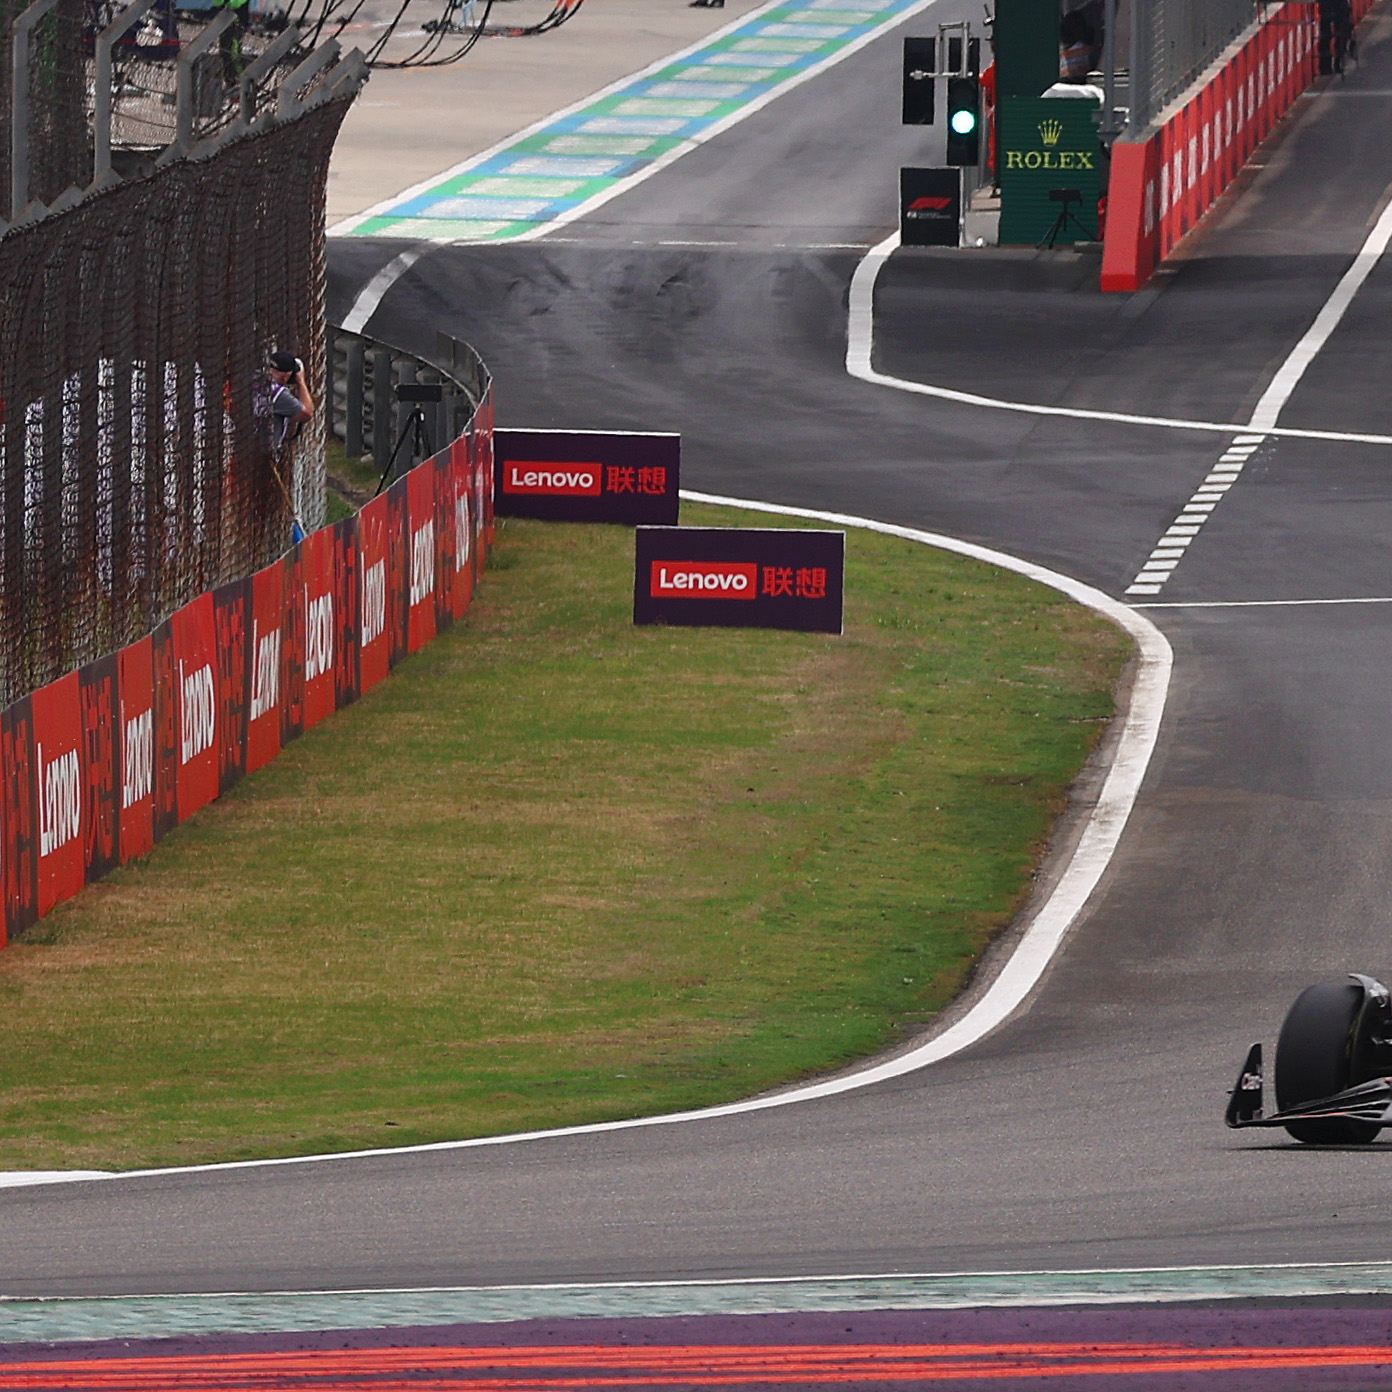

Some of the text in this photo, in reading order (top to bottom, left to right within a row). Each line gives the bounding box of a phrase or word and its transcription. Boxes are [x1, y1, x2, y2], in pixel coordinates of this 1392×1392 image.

[1006, 150, 1095, 169] ROLEX
[511, 465, 667, 495] Lenovo 联想
[659, 565, 827, 599] Lenovo 联想
[37, 741, 81, 858] Lenovo
